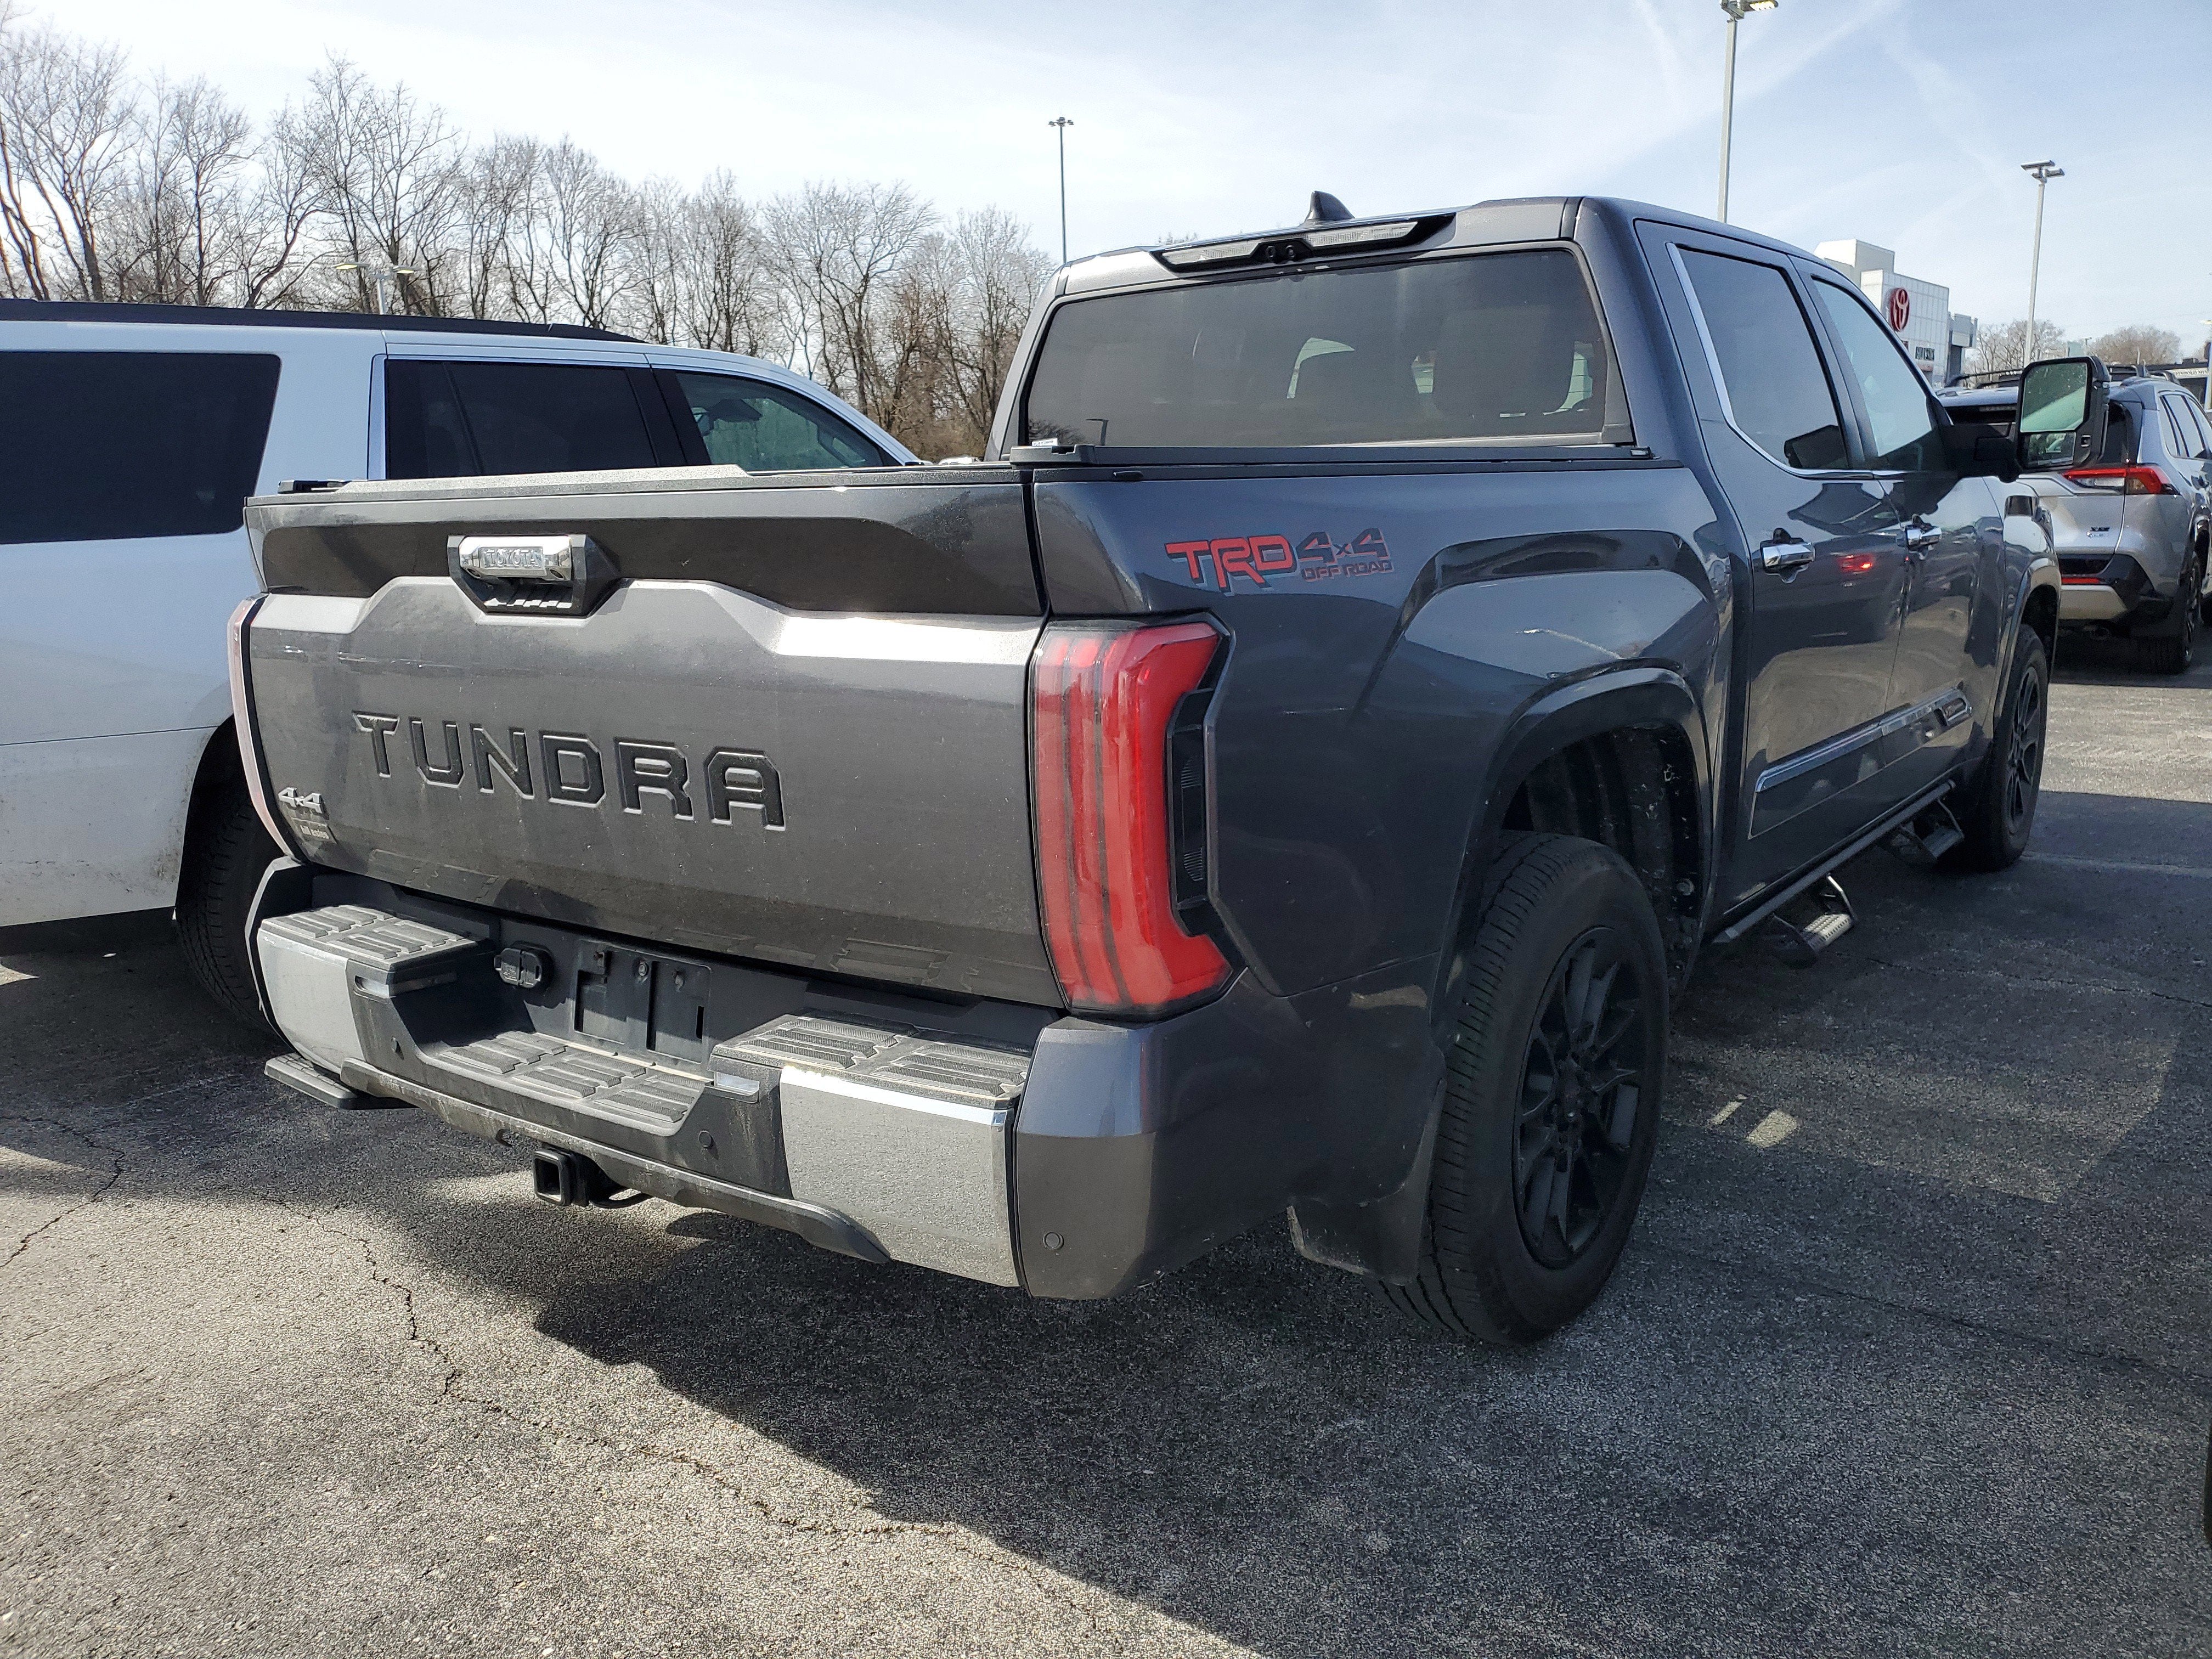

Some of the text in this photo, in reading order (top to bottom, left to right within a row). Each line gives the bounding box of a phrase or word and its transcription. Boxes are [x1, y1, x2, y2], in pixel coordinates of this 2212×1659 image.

[486, 549, 539, 568] TOYOTA
[1164, 527, 1390, 594] TRD 4x4
[1301, 559, 1395, 582] OFF ROAD
[351, 710, 786, 832] TUNDRA
[278, 786, 324, 814] 4x4
